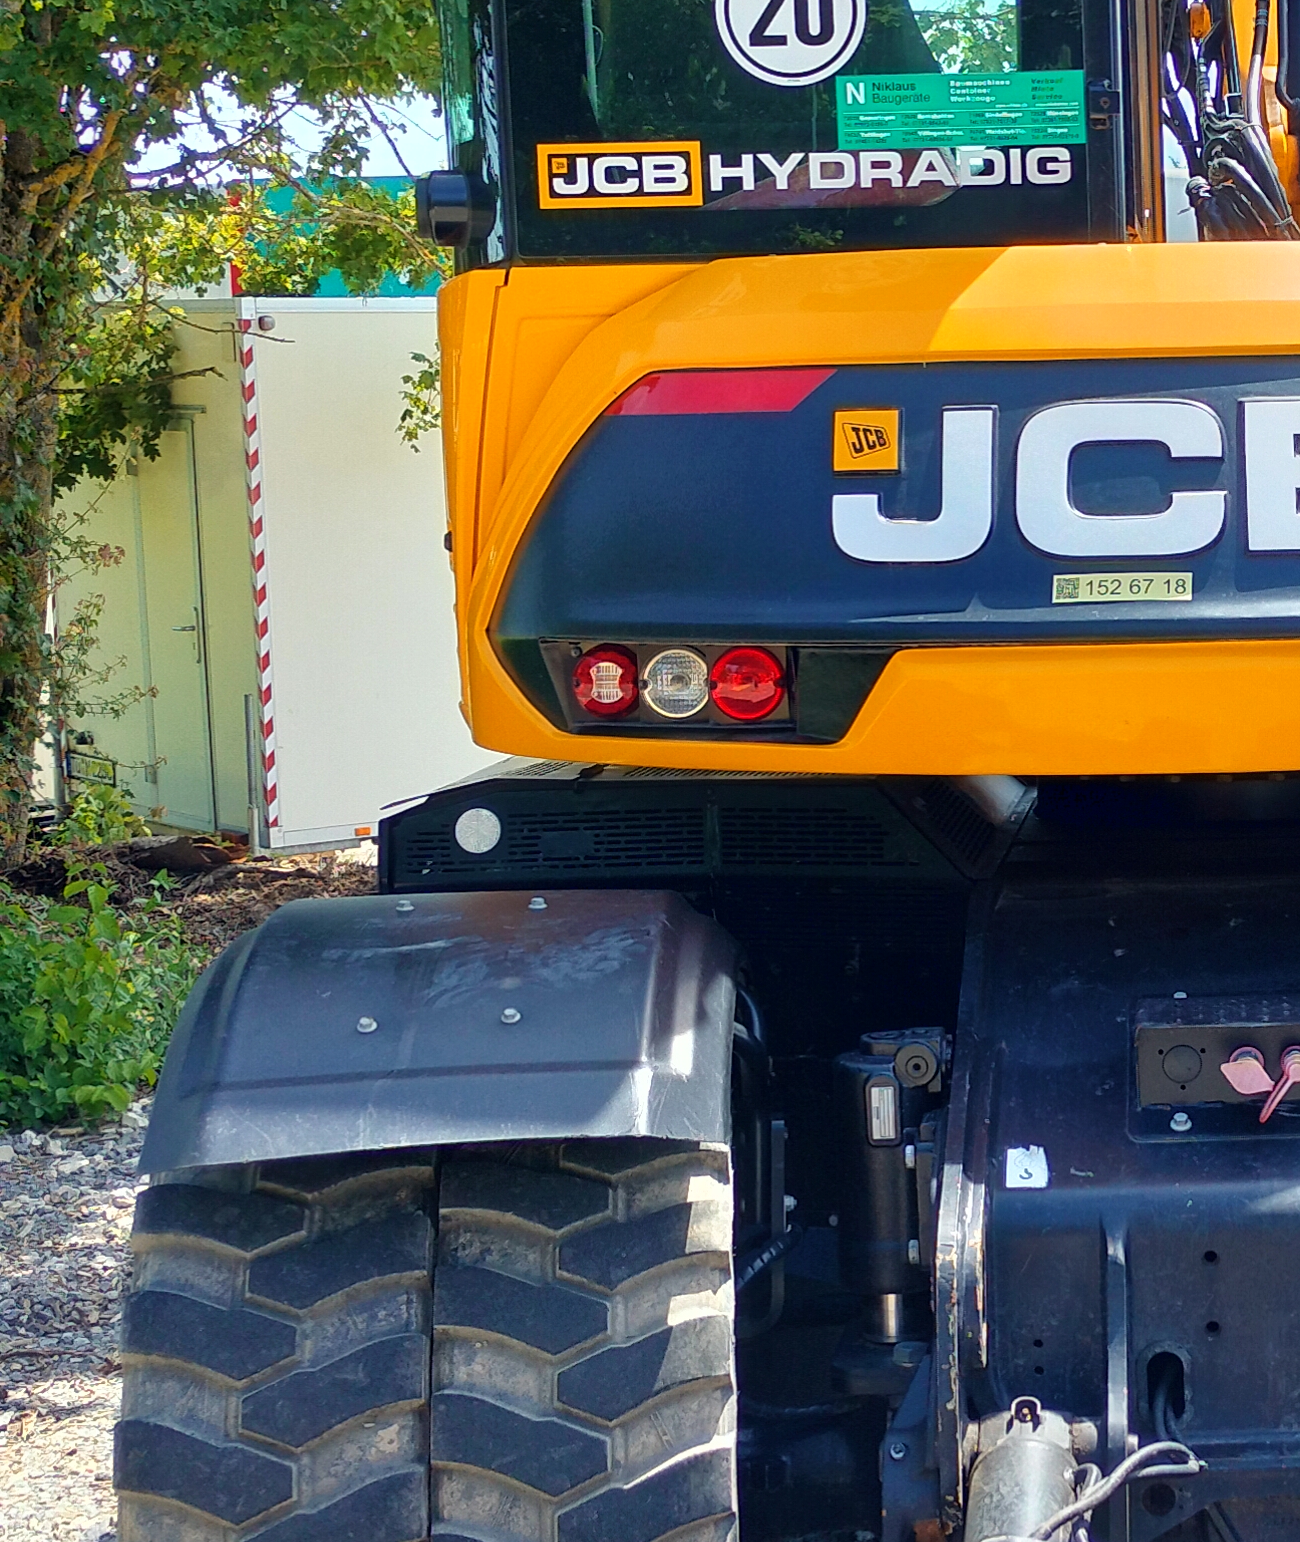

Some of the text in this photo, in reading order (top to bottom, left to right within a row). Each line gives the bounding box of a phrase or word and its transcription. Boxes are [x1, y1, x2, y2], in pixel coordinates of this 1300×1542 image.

[846, 82, 865, 105] N
[872, 82, 917, 92] Niklaus
[551, 146, 1072, 195] JCB HYDRADIG
[850, 426, 887, 455] JCB
[1085, 578, 1187, 596] 152 67 18
